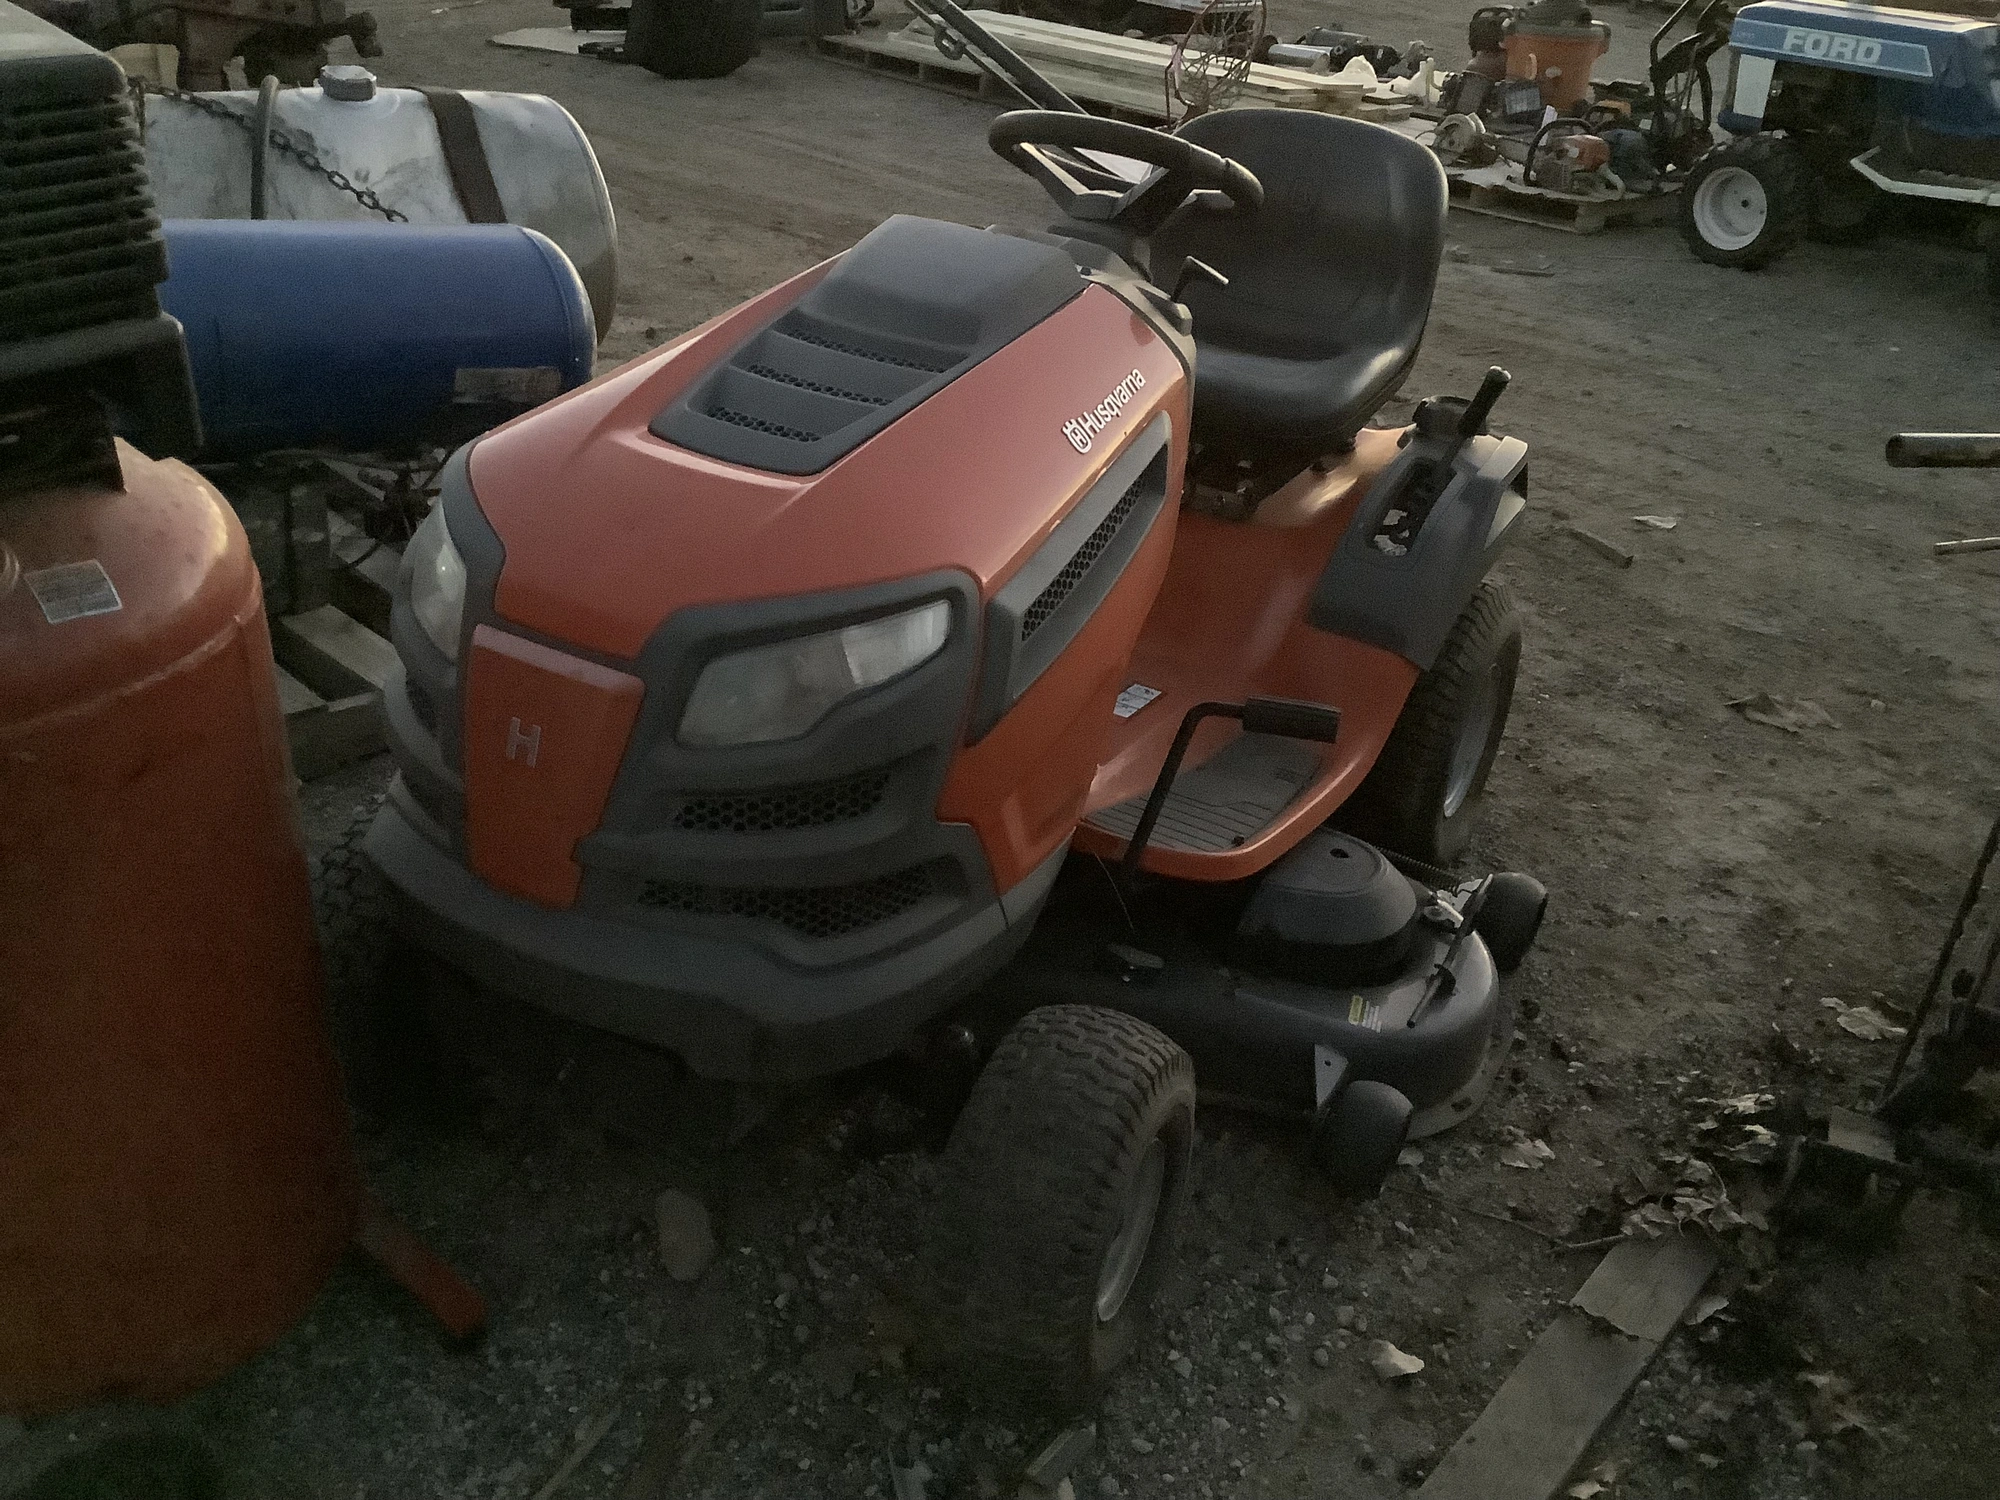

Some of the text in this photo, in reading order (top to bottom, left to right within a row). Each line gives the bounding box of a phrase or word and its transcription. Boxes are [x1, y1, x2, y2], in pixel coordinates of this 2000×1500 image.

[1783, 29, 1882, 64] FORD
[1077, 368, 1147, 439] Husqvarna
[506, 716, 541, 768] H
